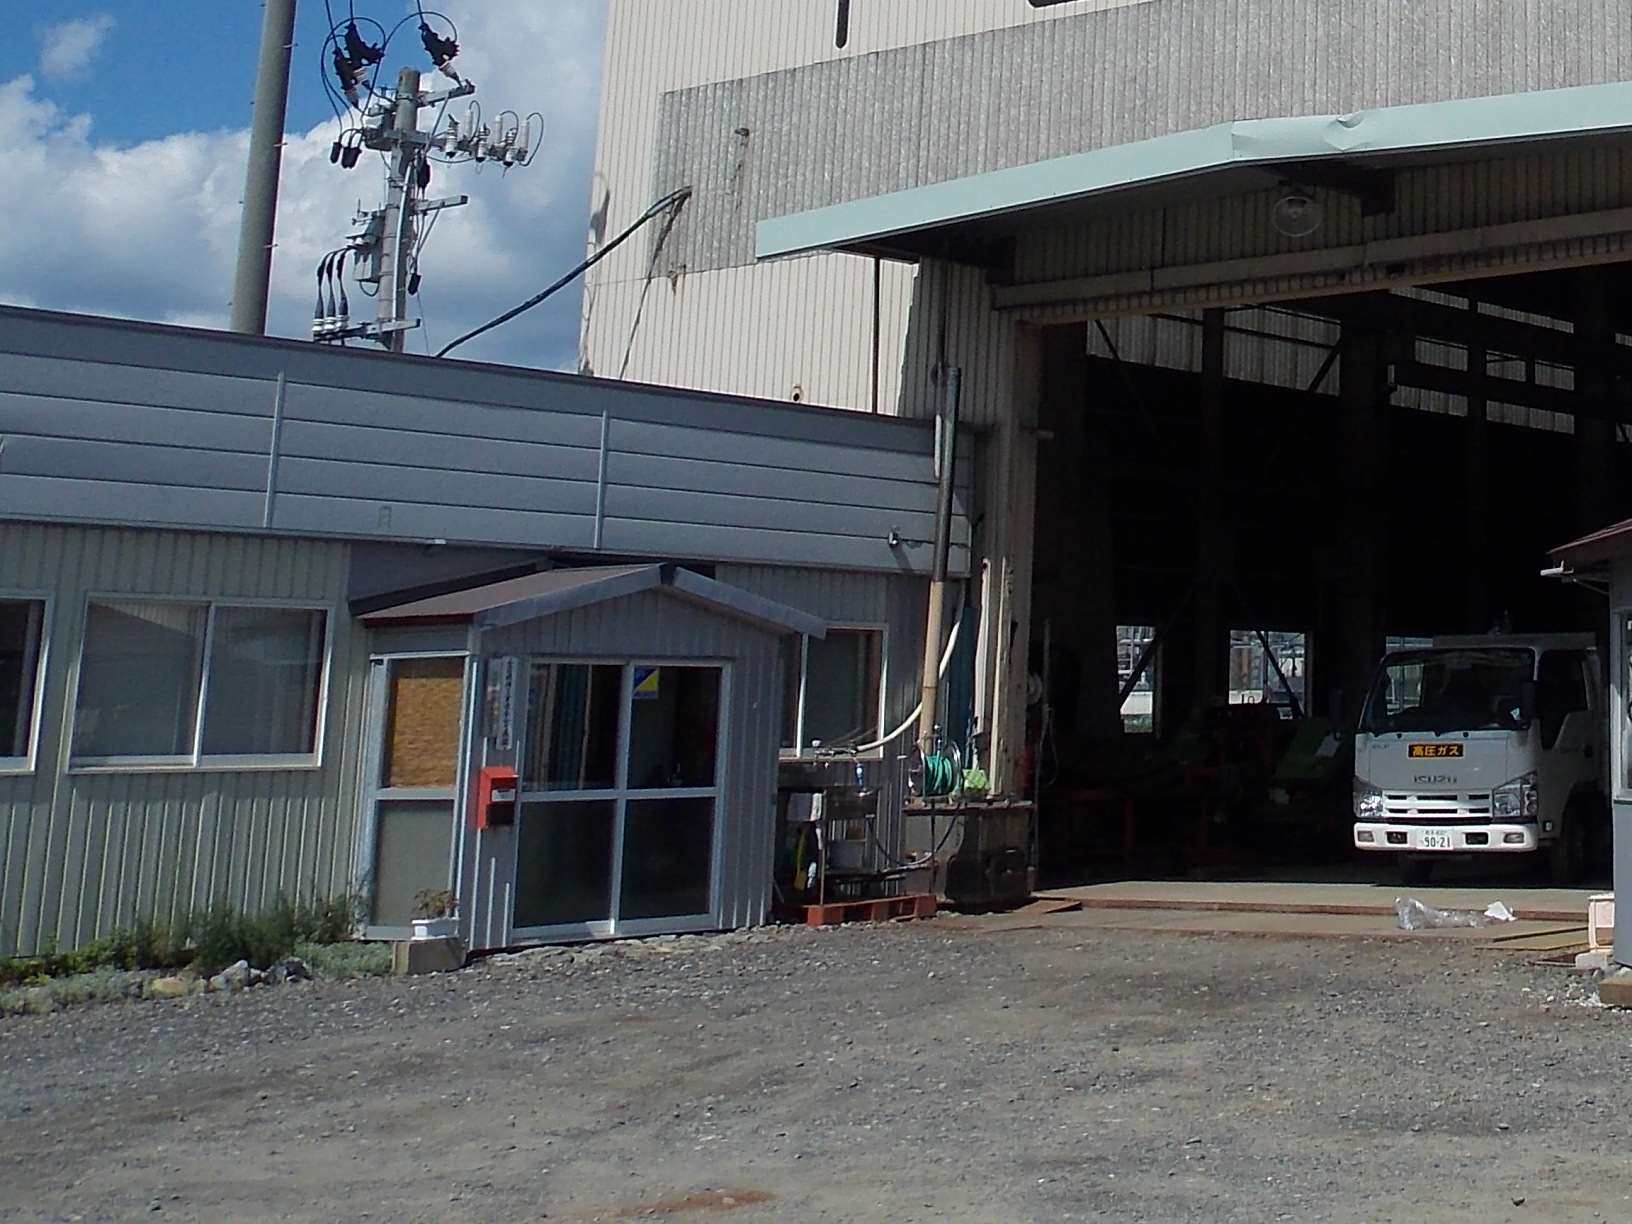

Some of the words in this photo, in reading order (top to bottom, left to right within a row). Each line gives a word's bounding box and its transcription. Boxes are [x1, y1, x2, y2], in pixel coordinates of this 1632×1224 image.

[1412, 744, 1460, 757] 高圧ガス
[1414, 774, 1458, 784] ISUZU
